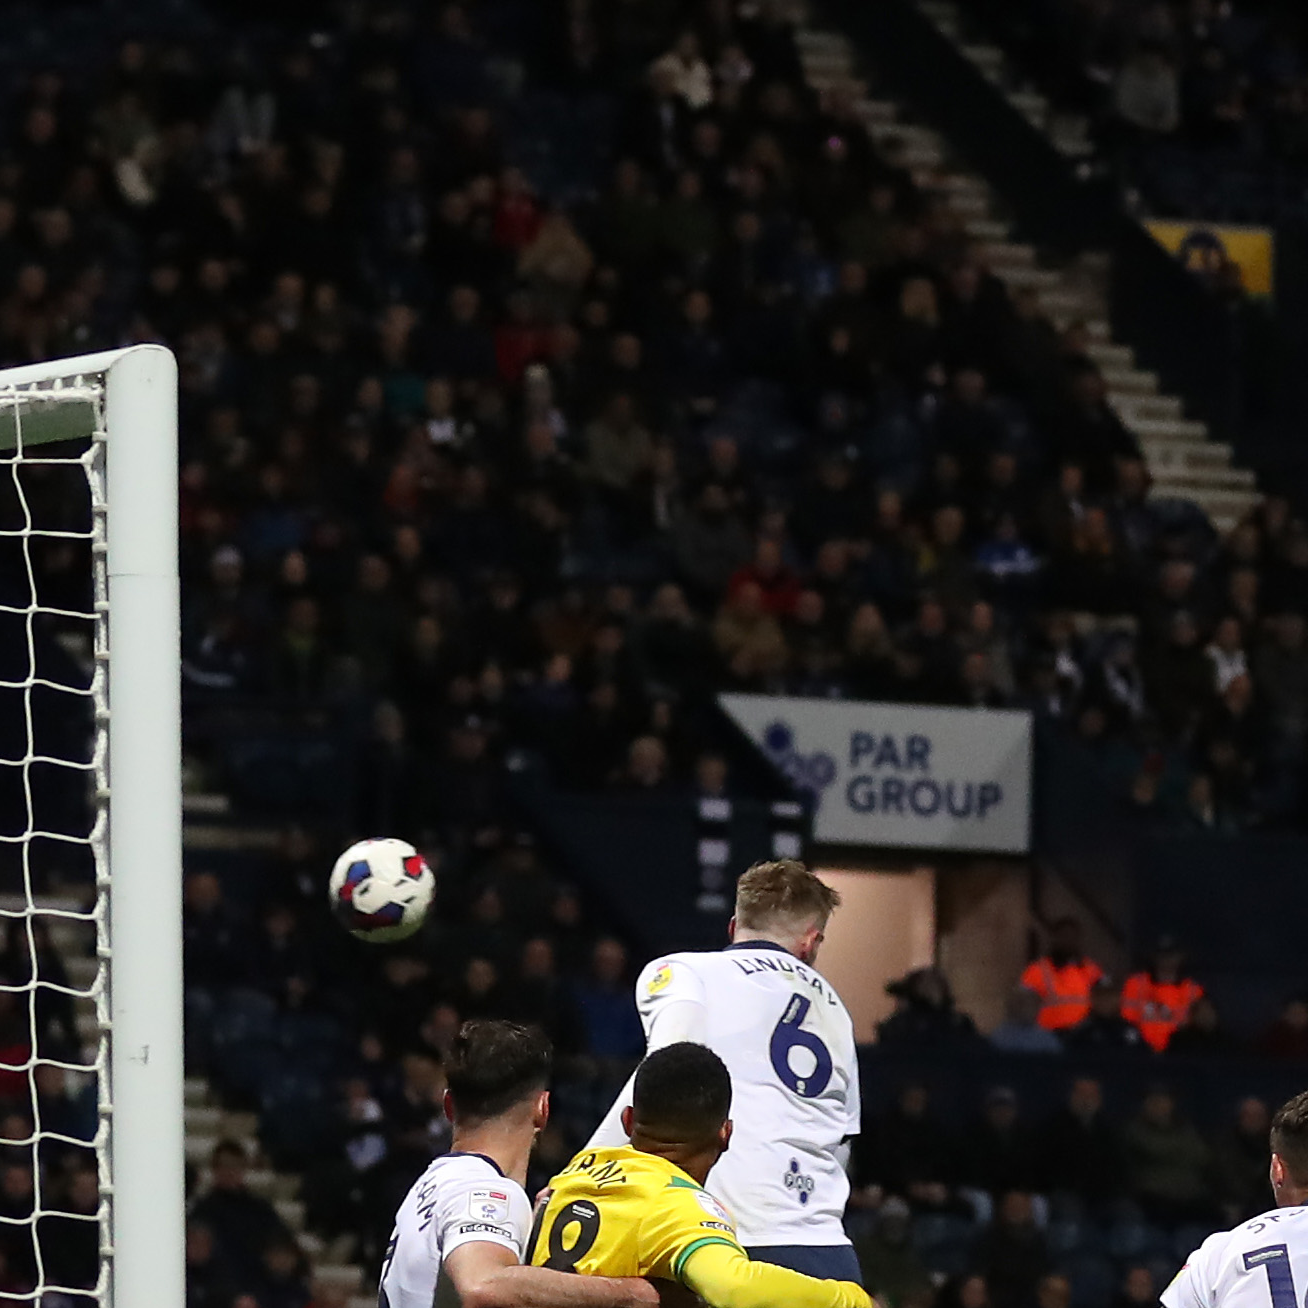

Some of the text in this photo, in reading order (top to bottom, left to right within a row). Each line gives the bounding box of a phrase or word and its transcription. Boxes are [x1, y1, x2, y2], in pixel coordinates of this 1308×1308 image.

[848, 731, 932, 771] PAR
[845, 775, 1003, 819] GROUP
[770, 992, 833, 1099] 6
